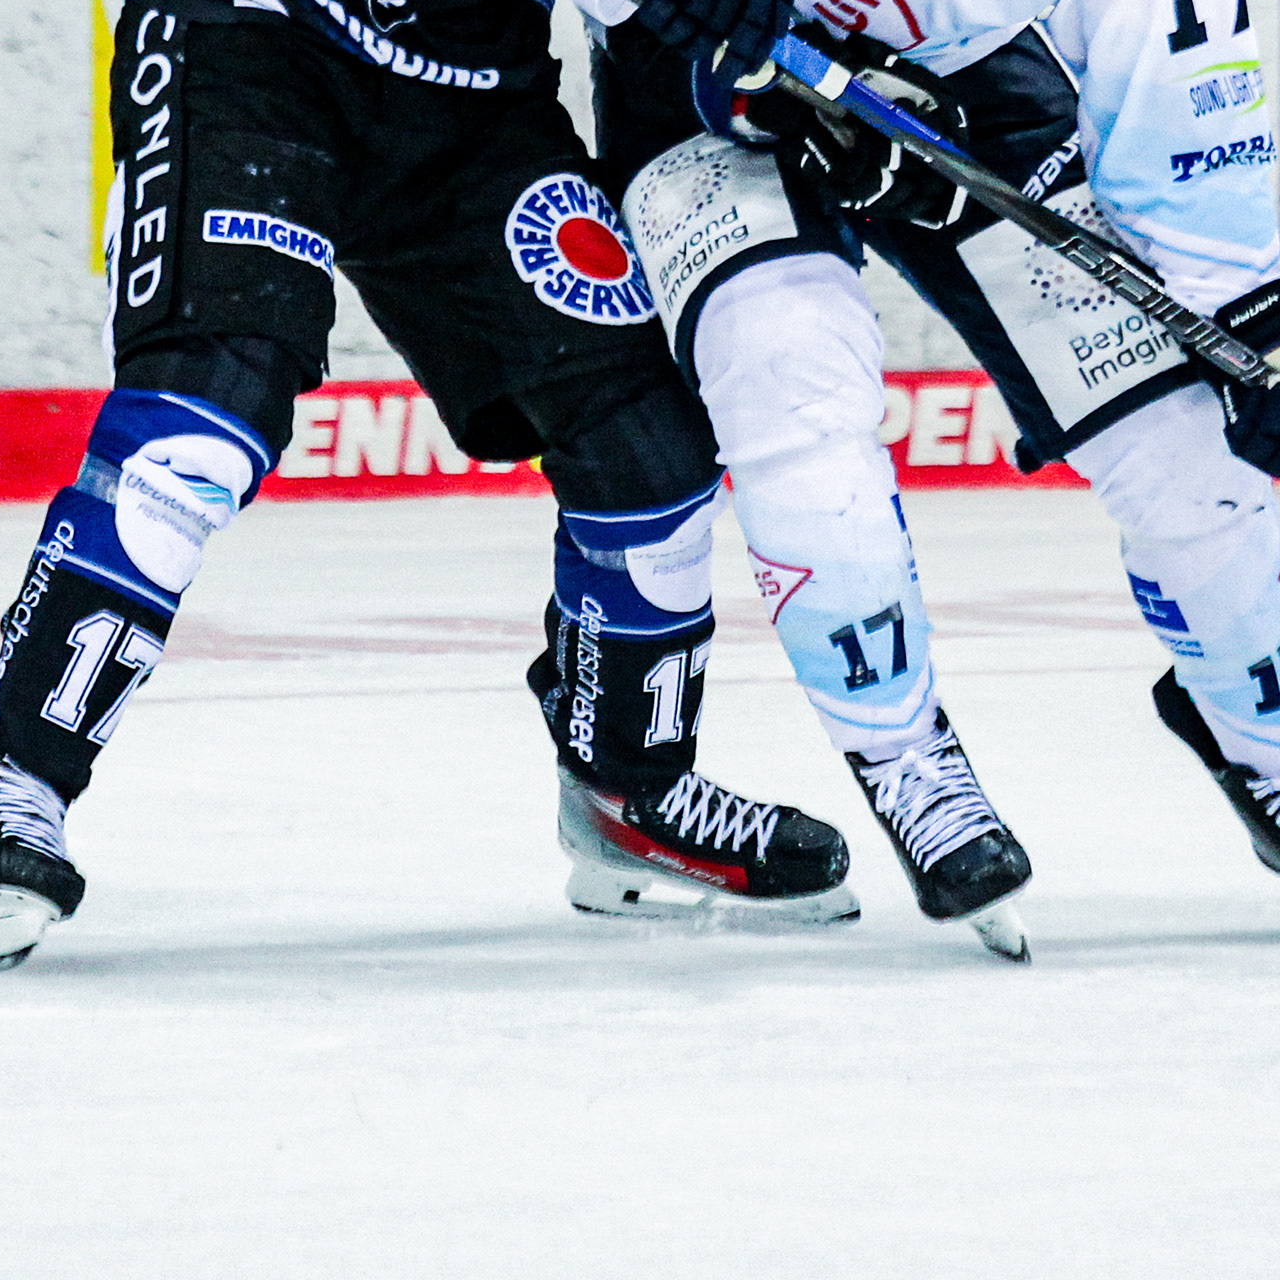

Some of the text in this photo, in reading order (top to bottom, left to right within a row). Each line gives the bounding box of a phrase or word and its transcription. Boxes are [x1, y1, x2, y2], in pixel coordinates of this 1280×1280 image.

[128, 8, 177, 309] CONLED
[659, 204, 740, 291] Beyond
[1077, 330, 1184, 391] Imagin
[276, 394, 517, 480] ENN
[39, 608, 166, 747] 17
[828, 601, 909, 694] 17
